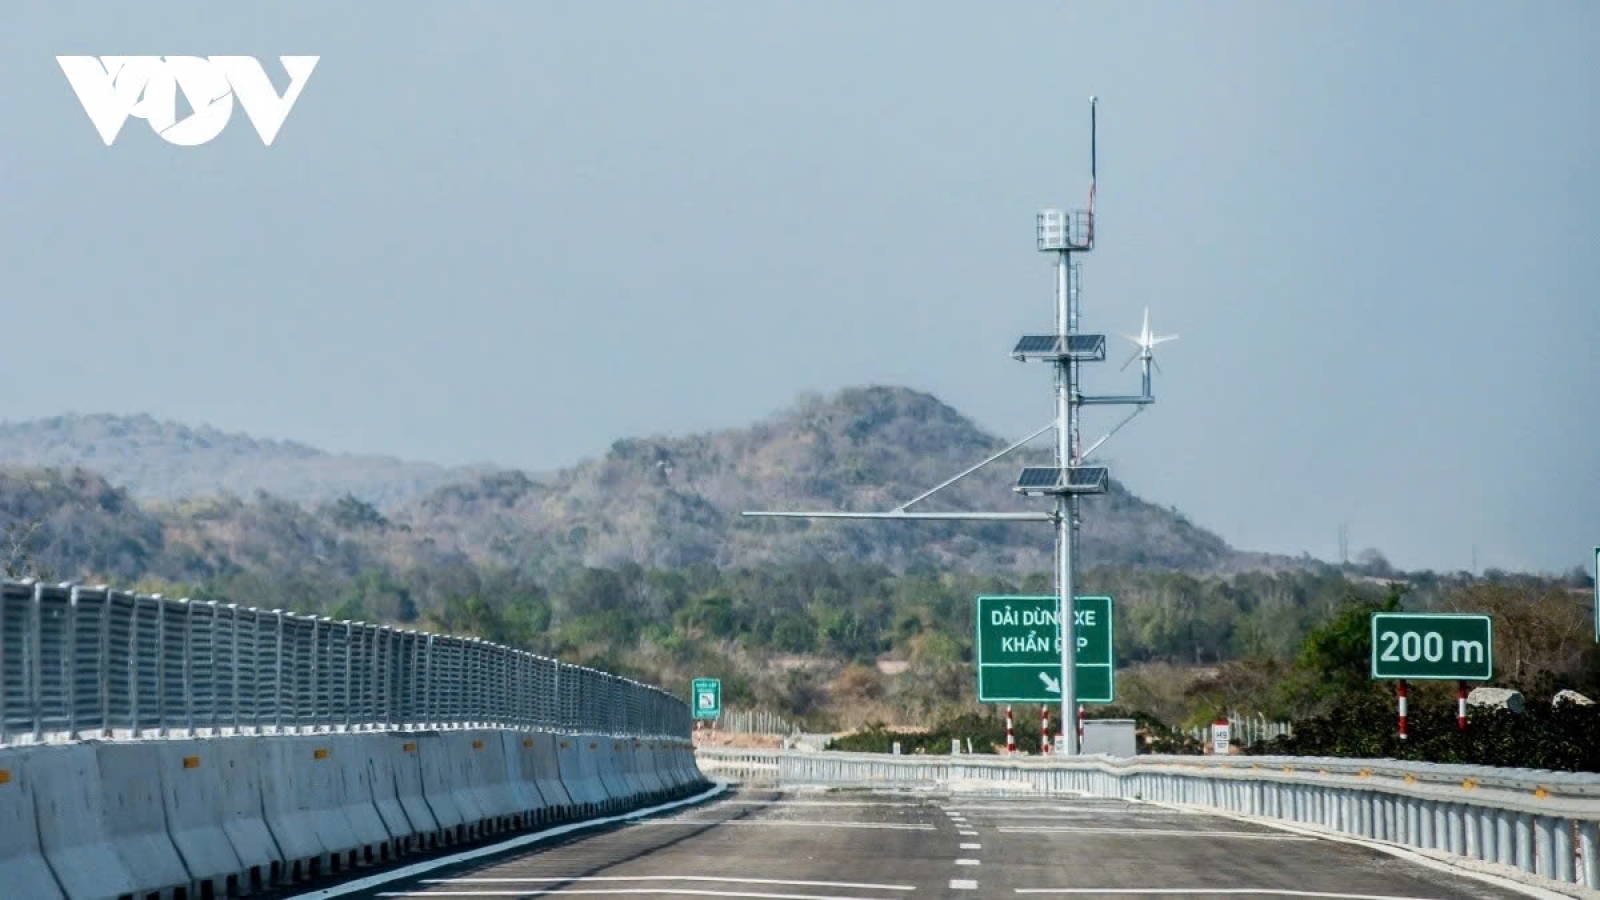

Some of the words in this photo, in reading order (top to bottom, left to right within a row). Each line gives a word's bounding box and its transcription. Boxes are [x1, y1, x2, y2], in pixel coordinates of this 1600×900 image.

[991, 605, 1018, 626] DẢI
[1074, 610, 1097, 626] XE
[1002, 630, 1050, 653] KHẨN
[1380, 631, 1443, 662] 200
[1451, 640, 1484, 663] m
